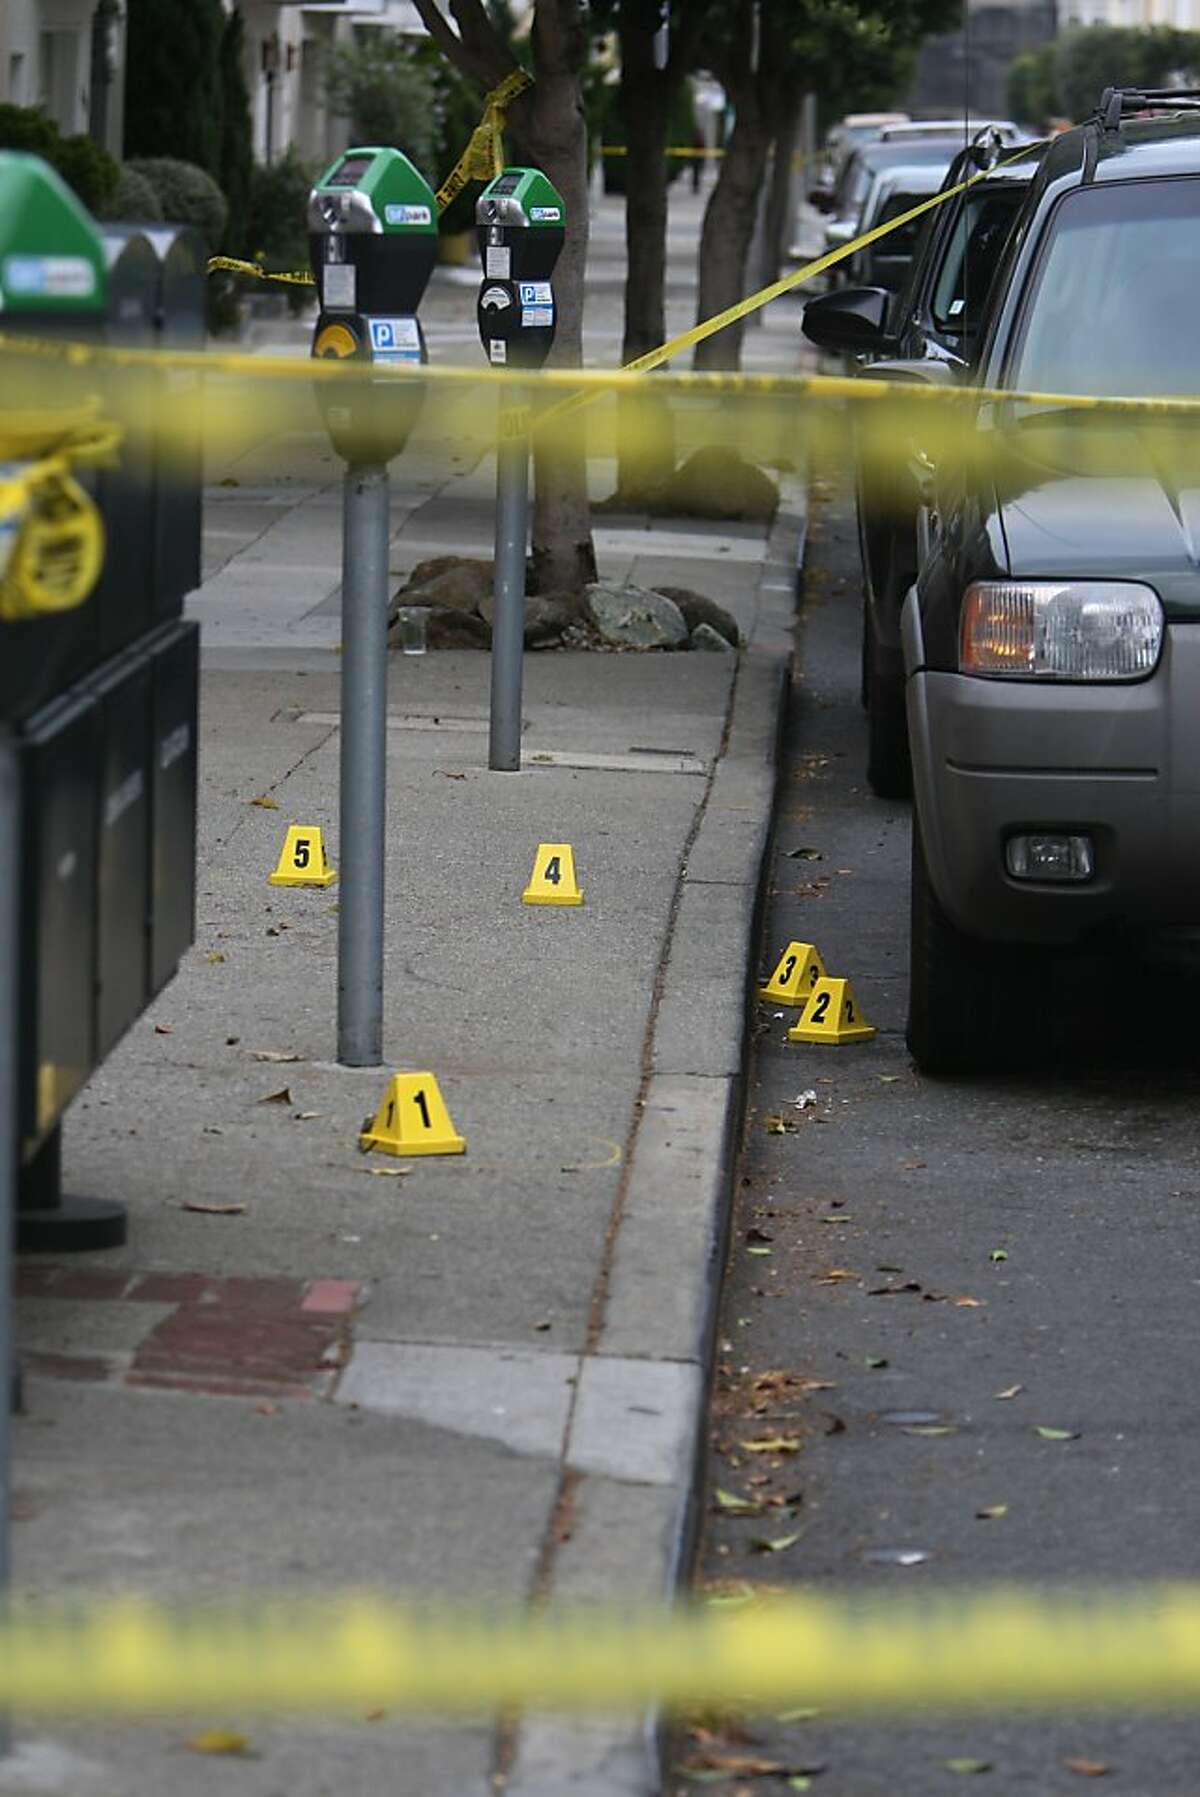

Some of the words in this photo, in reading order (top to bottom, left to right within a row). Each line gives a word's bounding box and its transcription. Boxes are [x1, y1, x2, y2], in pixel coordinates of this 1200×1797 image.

[294, 840, 311, 869] 5
[544, 856, 562, 885] 4
[779, 955, 797, 985] 3
[810, 992, 831, 1024] 2
[846, 1000, 855, 1023] 2
[386, 1100, 394, 1129] 1
[413, 1090, 431, 1128] 1
